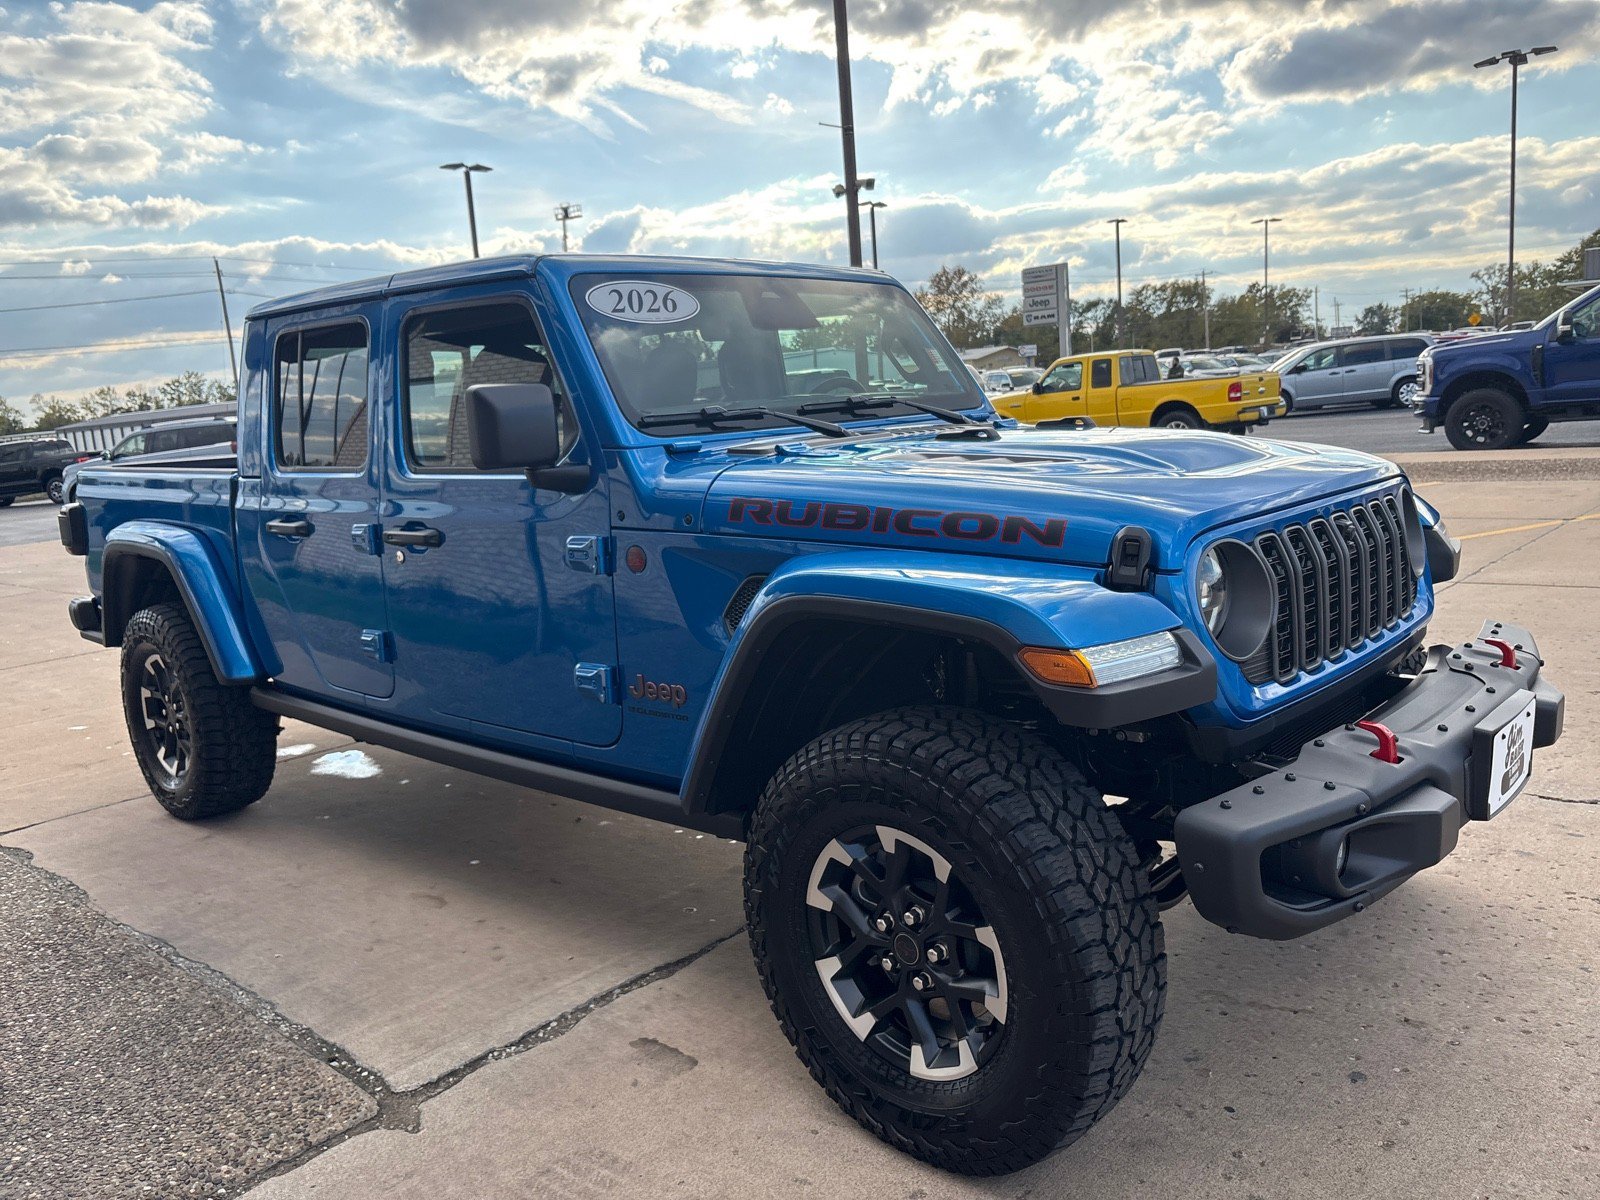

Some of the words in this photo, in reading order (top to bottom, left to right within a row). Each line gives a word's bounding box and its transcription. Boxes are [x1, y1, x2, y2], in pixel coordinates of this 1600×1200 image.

[608, 289, 678, 313] 2026
[1028, 299, 1050, 308] Jeep
[728, 497, 1068, 548] RUBICON
[628, 673, 687, 709] Jeep
